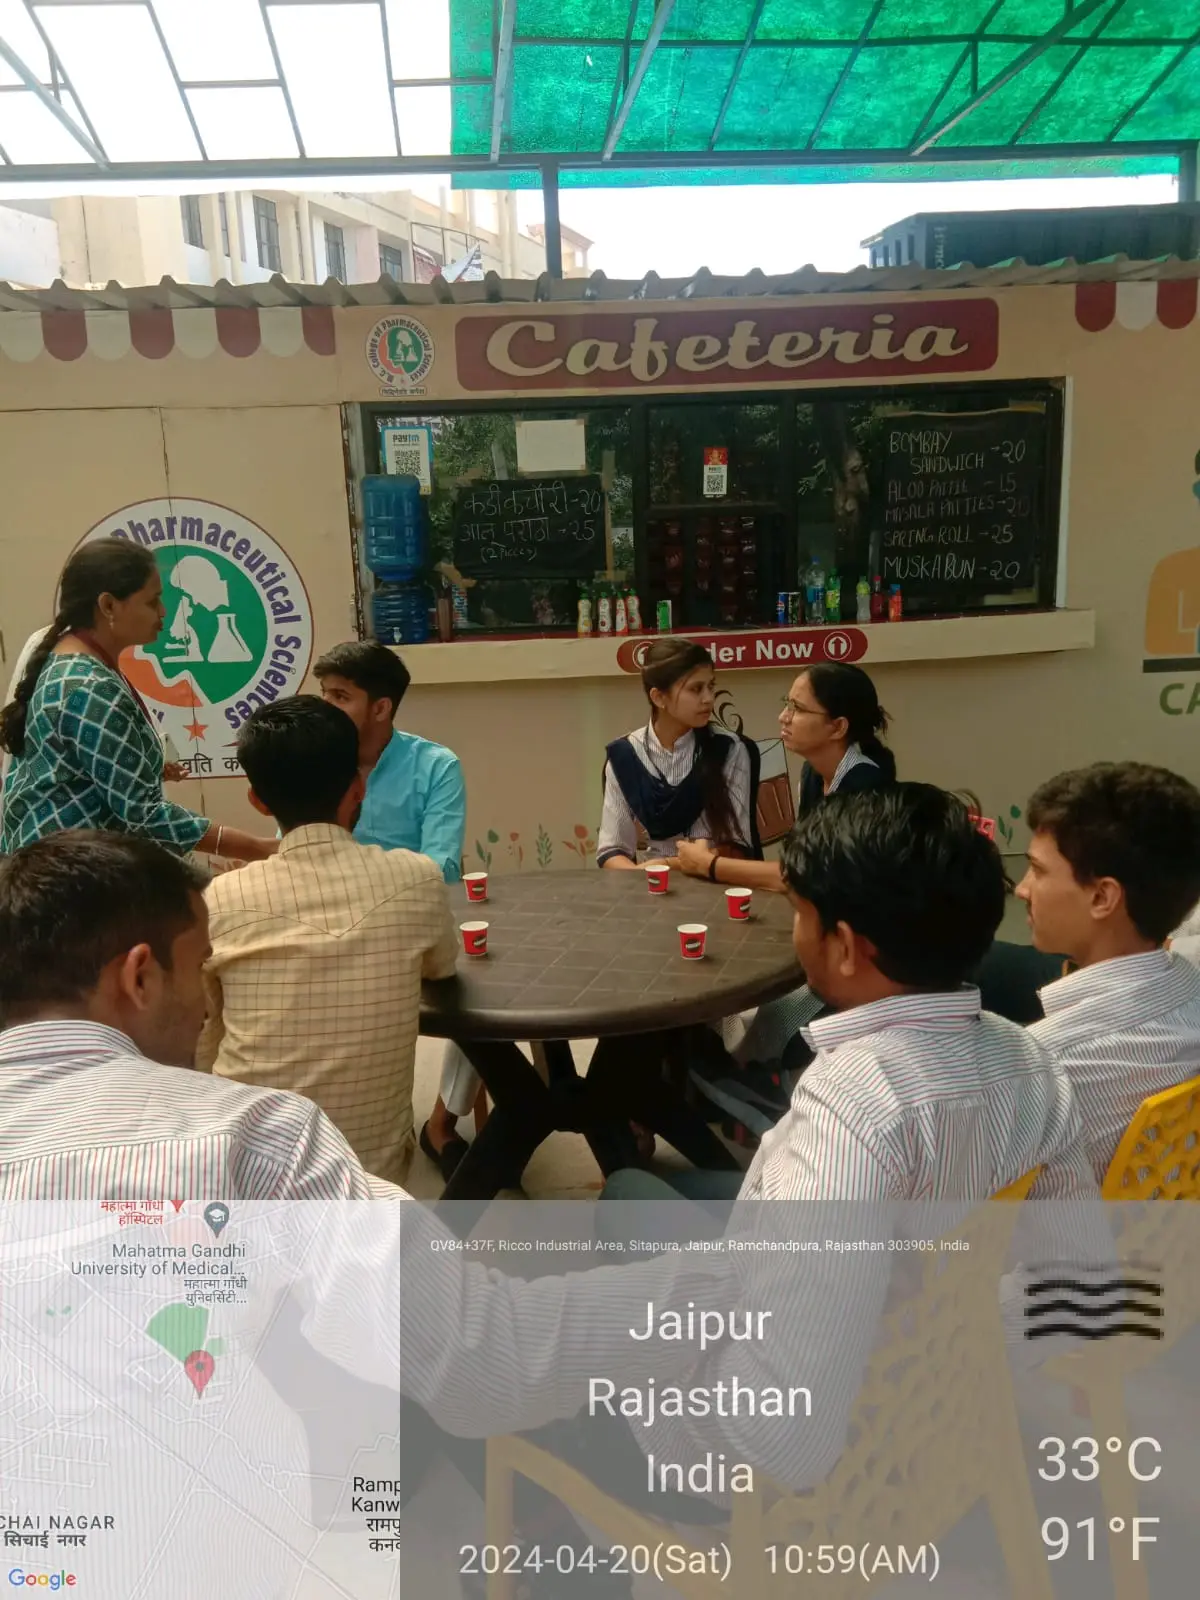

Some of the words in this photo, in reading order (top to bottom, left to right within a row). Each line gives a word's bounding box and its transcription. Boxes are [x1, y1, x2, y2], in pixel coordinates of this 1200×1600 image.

[486, 314, 969, 382] Cafeteria
[890, 430, 953, 454] BOMBAY
[910, 452, 985, 475] SANDWICH
[755, 639, 814, 661] Now
